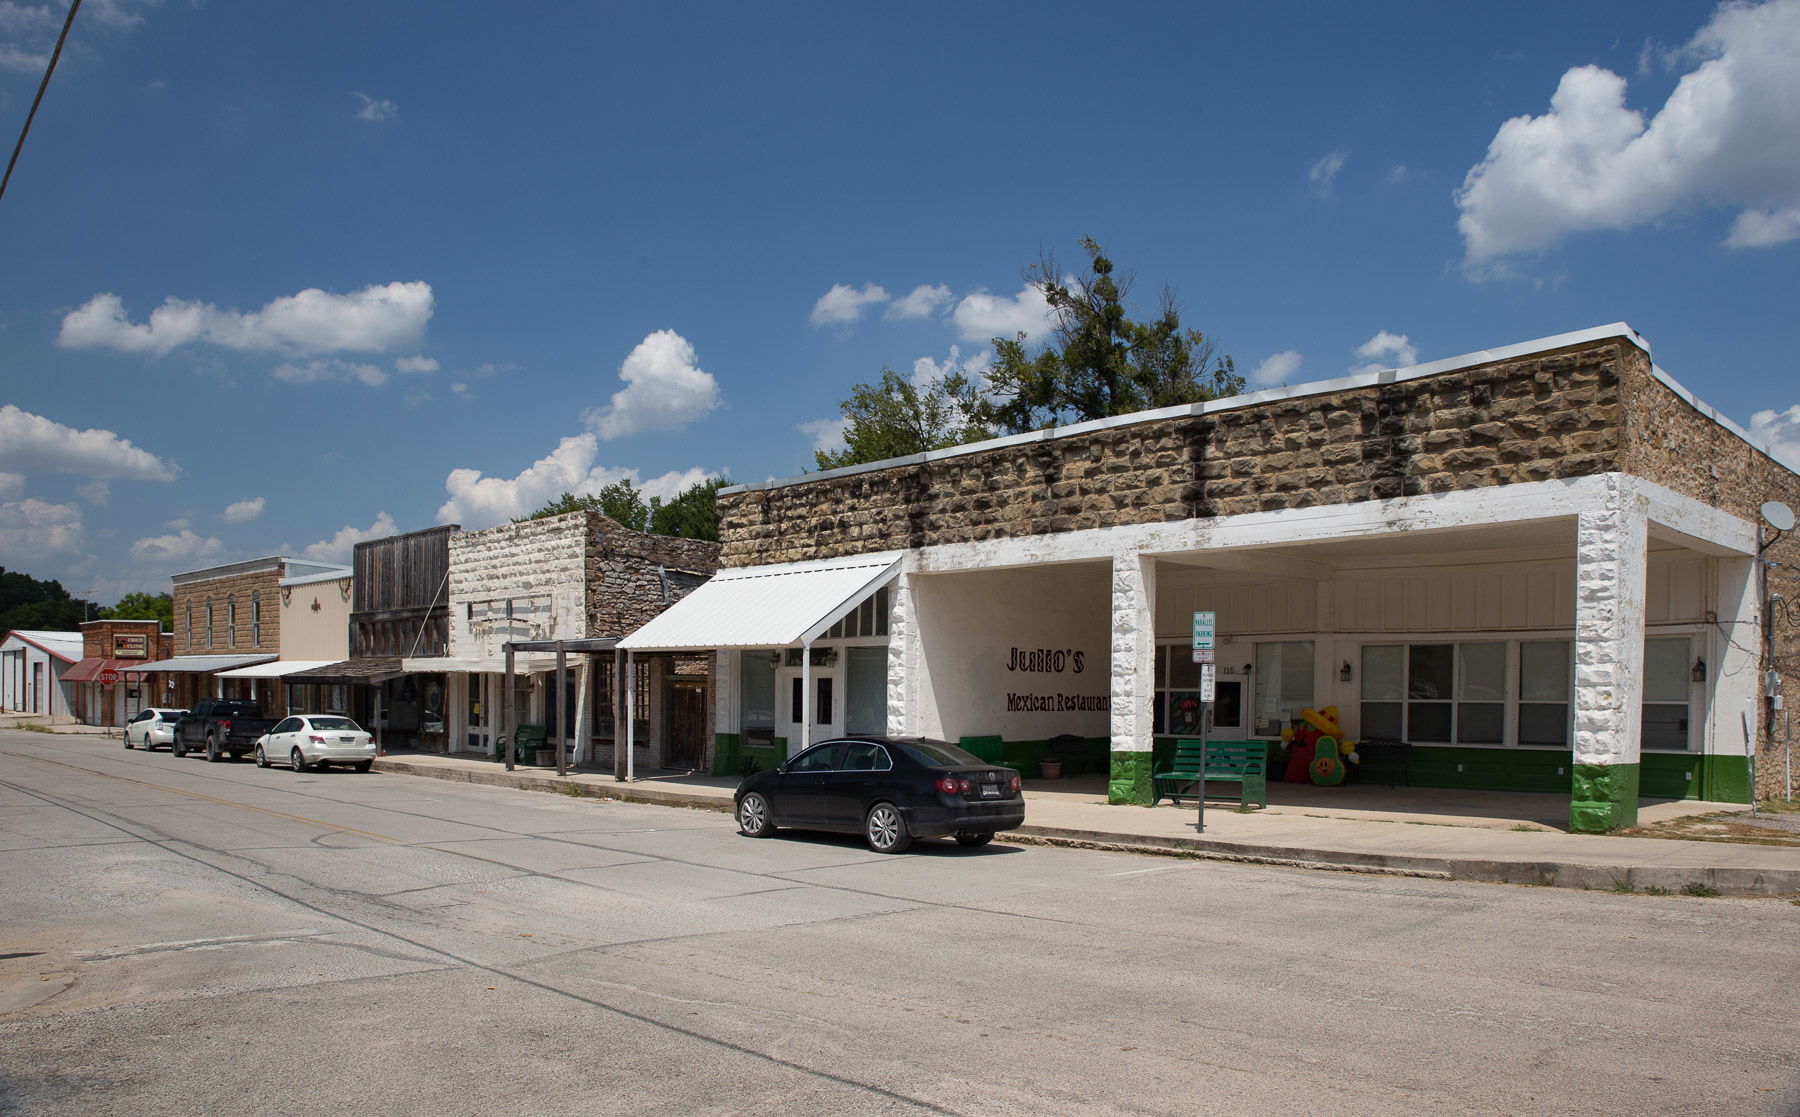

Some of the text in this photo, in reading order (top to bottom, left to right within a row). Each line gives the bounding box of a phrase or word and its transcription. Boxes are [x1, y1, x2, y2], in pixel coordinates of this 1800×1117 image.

[1223, 667, 1235, 675] 115
[100, 673, 118, 681] STOP
[1006, 693, 1055, 712] Mexican
